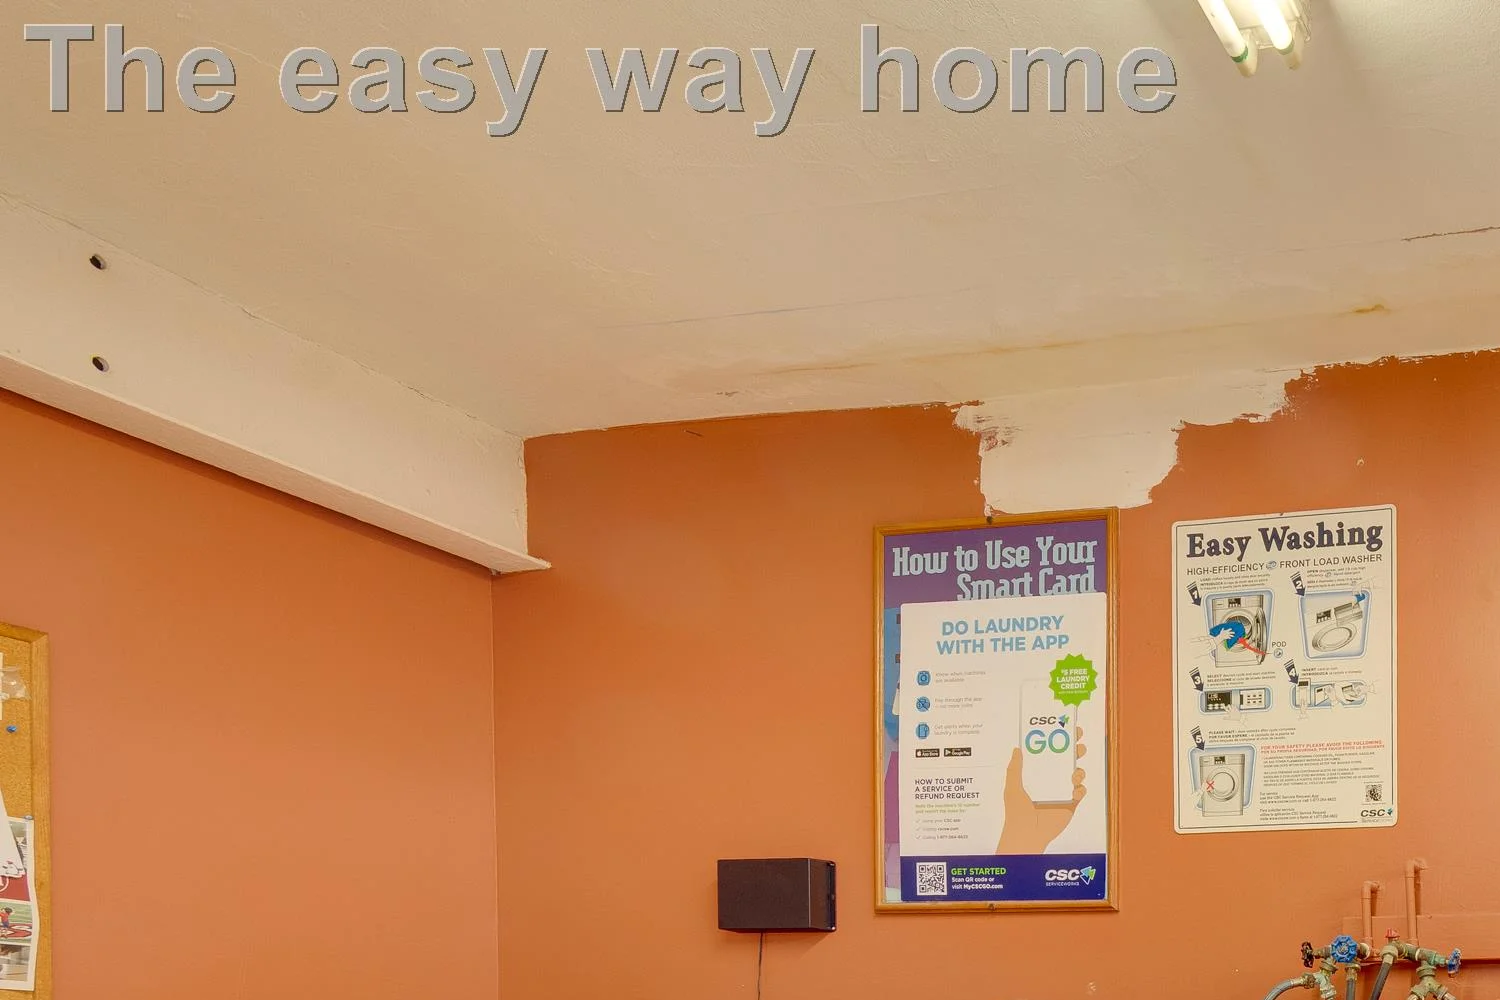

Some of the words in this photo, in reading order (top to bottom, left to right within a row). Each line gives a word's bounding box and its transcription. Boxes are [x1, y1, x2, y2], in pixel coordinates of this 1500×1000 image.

[1186, 533, 1251, 562] Easy
[1258, 521, 1383, 552] Washing
[892, 547, 949, 576] How
[954, 546, 979, 572] to
[985, 540, 1030, 570] Use
[1036, 536, 1098, 566] Your
[1186, 562, 1264, 576] HIGH-EFFICIENCY
[1279, 559, 1311, 568] FRONT
[1313, 557, 1340, 566] LOAD
[1342, 554, 1383, 564] WASHER
[957, 573, 1032, 600] Smart
[1039, 565, 1096, 597] Card
[942, 620, 968, 636] DO
[974, 615, 1064, 635] LAUNDRY
[937, 638, 985, 655] WITH
[990, 636, 1026, 653] THE
[1032, 634, 1069, 650] APP
[1056, 675, 1090, 683] LAUNDRY
[1060, 682, 1087, 690] CREDIT
[1029, 716, 1057, 726] CSC
[1025, 728, 1071, 755] GO
[1361, 808, 1386, 817] CSC
[951, 867, 967, 876] GET
[969, 867, 1006, 875] STARTED
[1045, 869, 1080, 881] CSC
